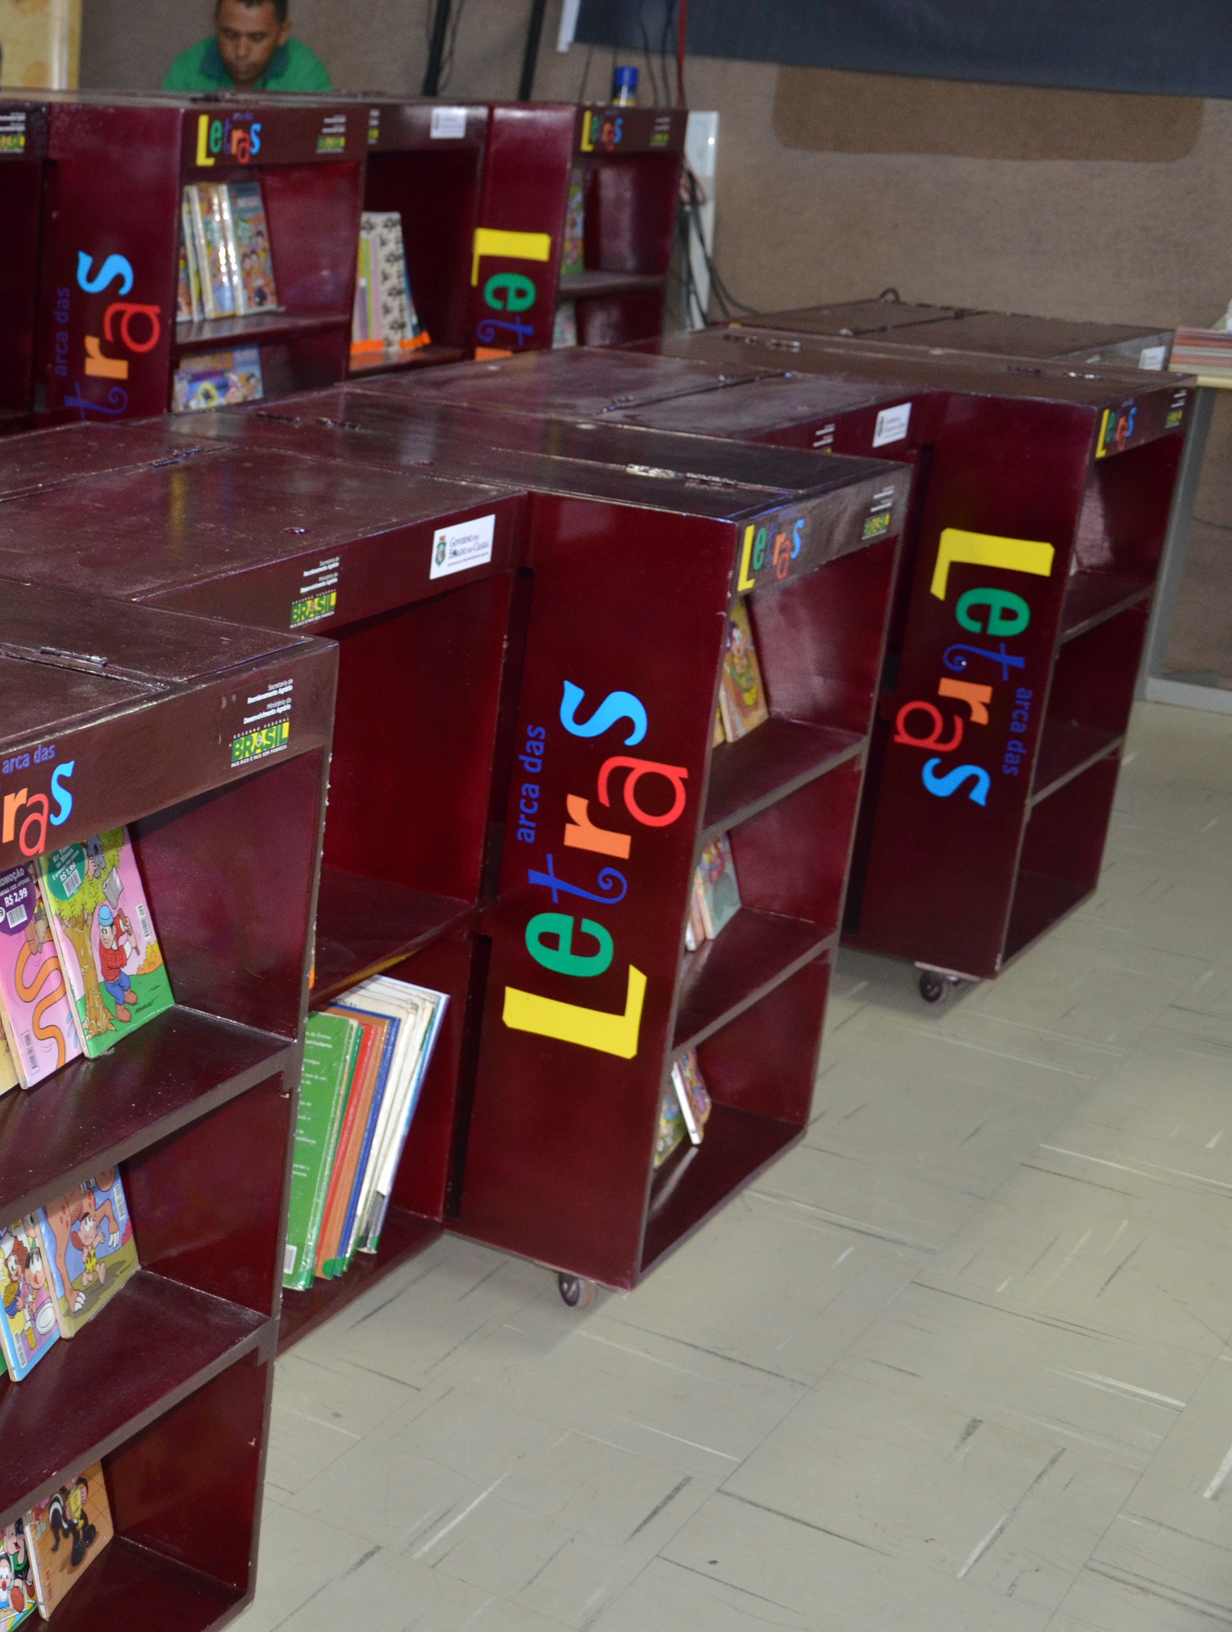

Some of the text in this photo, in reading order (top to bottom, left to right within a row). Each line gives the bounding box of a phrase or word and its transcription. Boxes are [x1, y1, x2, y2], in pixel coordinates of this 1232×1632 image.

[196, 114, 262, 166] Letras
[54, 287, 70, 377] arca das
[1096, 407, 1137, 458] Letras
[738, 518, 805, 592] Letras
[290, 592, 337, 623] BRASIL
[894, 528, 1055, 807] Letras
[2, 744, 56, 774] arca das
[232, 722, 290, 762] BRASIL
[1002, 687, 1033, 776] arca das
[517, 724, 546, 843] arca das
[4, 888, 28, 908] R$ 2,99
[502, 680, 688, 1060] Letras
